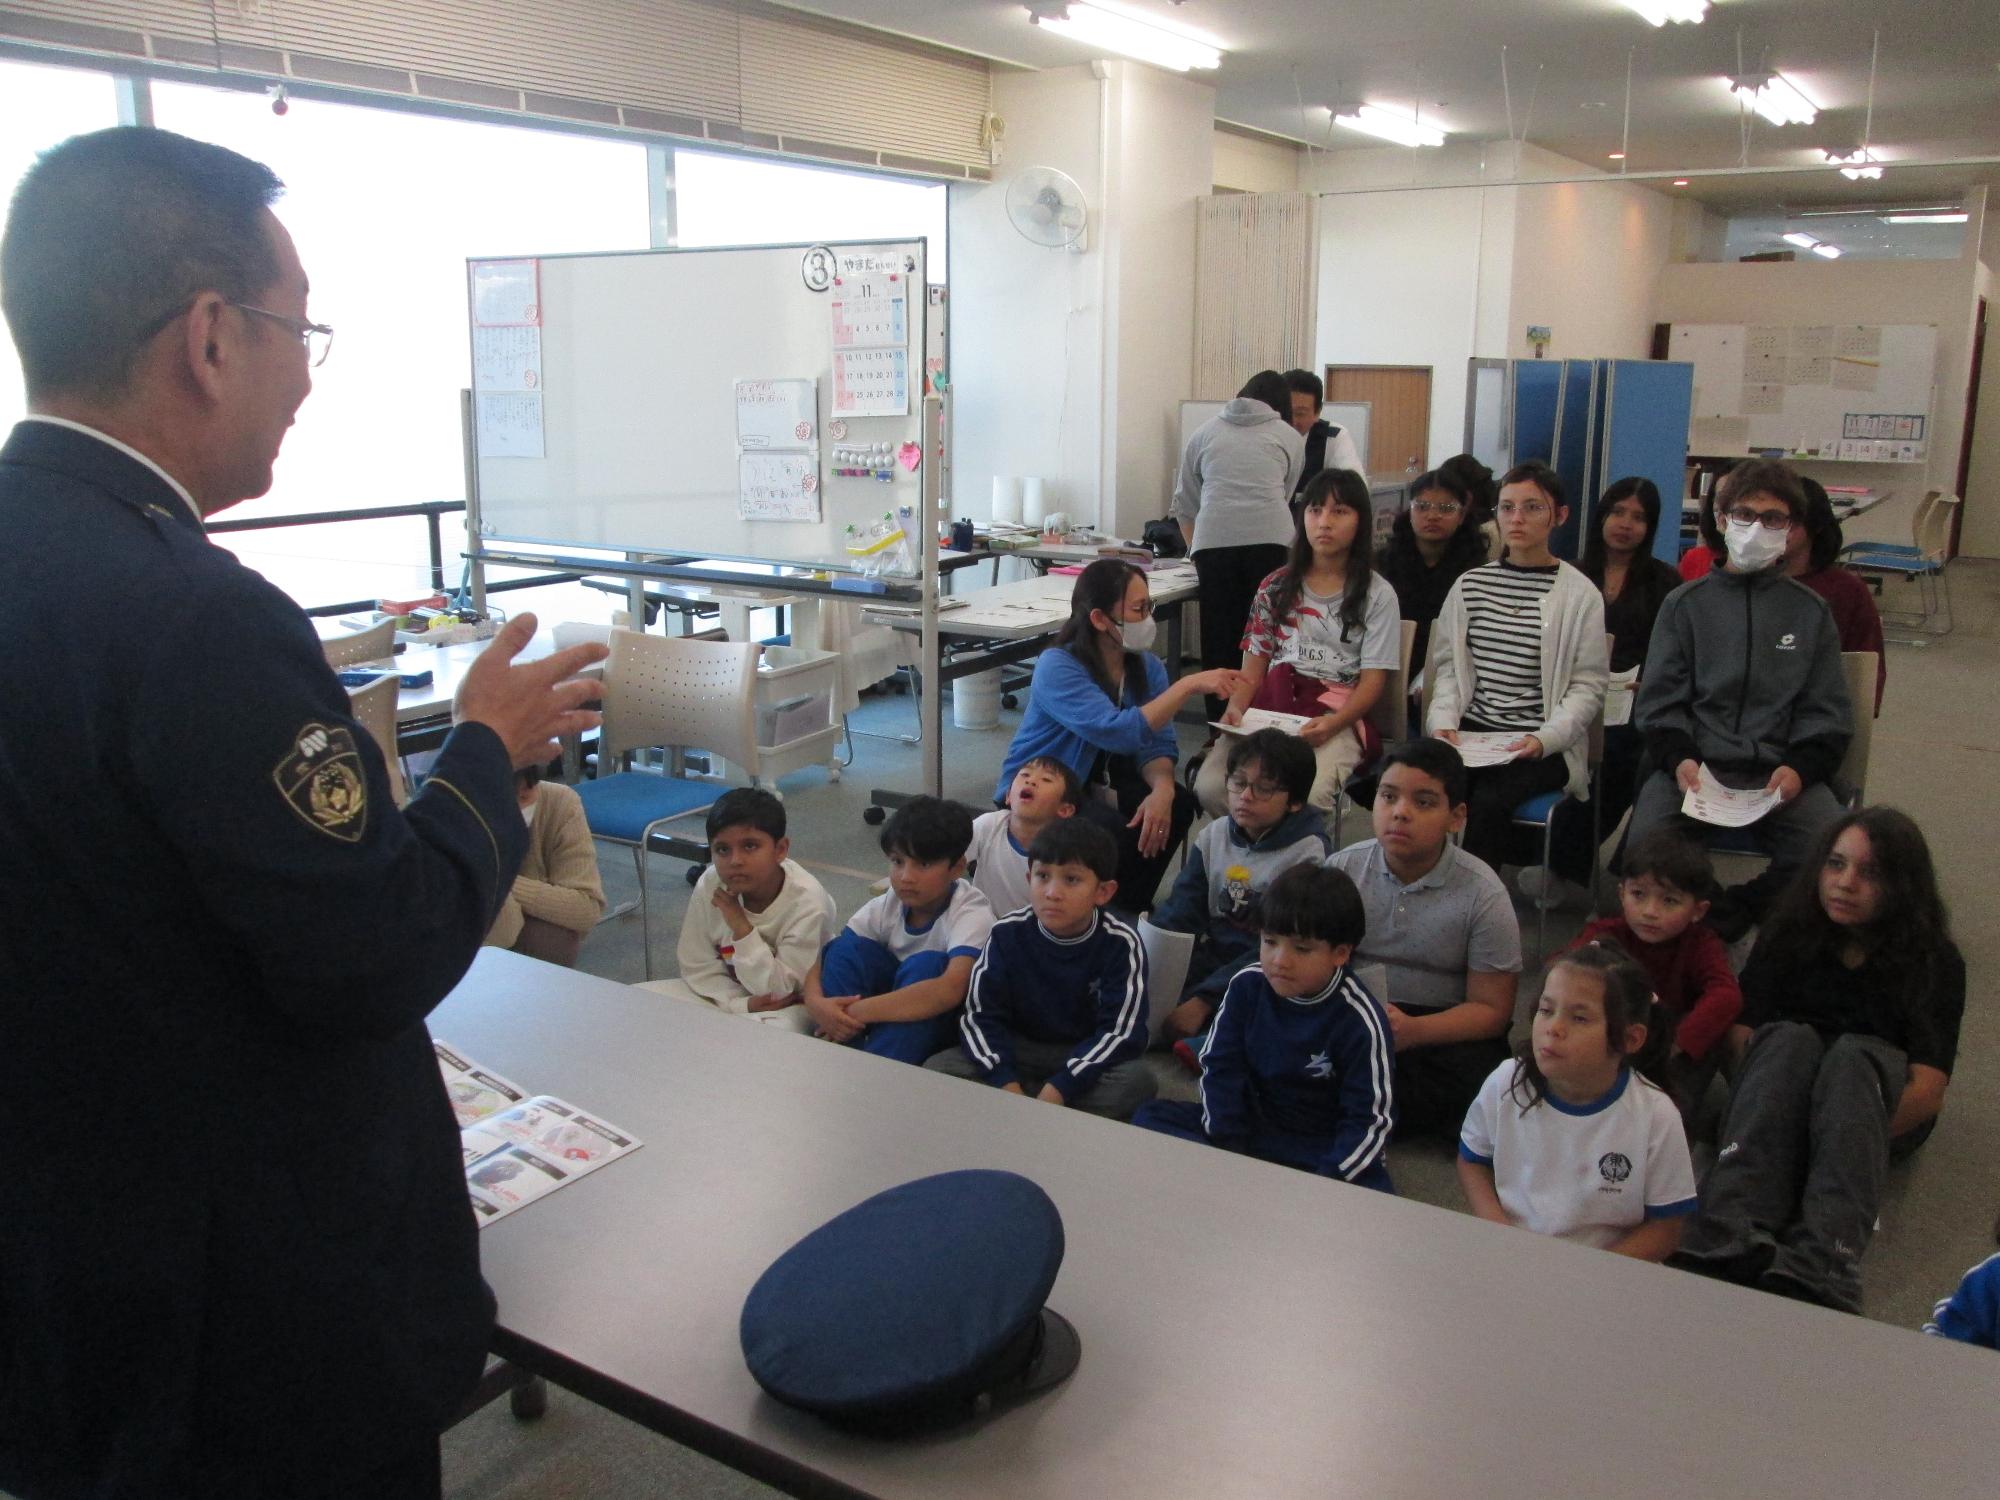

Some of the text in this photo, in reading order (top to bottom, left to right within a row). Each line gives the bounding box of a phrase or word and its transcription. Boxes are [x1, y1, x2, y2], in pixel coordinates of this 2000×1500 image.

[861, 284, 871, 298] 11
[855, 353, 861, 361] 11
[856, 372, 863, 380] 18
[876, 371, 883, 379] 20
[886, 371, 893, 379] 21
[856, 391, 863, 399] 25
[876, 390, 883, 398] 27
